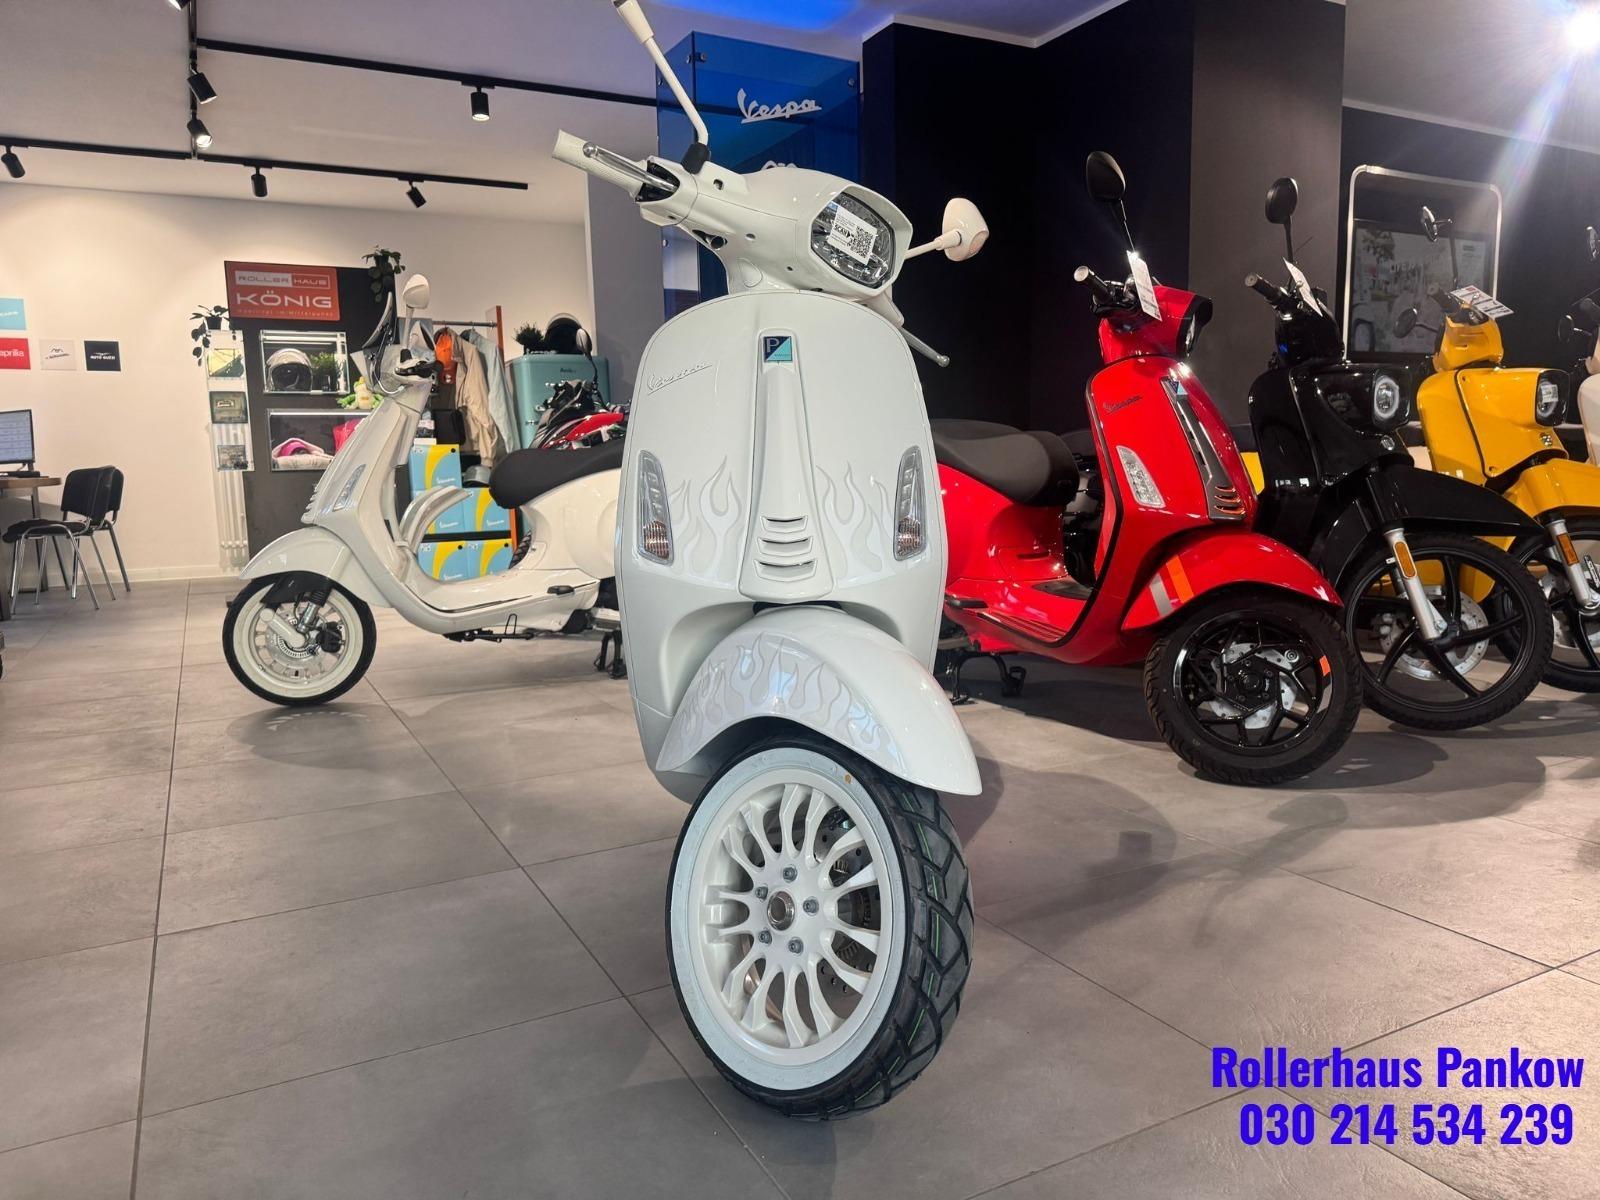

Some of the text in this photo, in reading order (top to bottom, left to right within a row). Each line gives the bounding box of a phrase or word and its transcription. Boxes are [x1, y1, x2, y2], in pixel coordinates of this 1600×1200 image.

[737, 88, 822, 124] Vespa
[238, 275, 289, 283] ROLLER
[236, 290, 332, 309] KÖNIG
[766, 337, 780, 353] P
